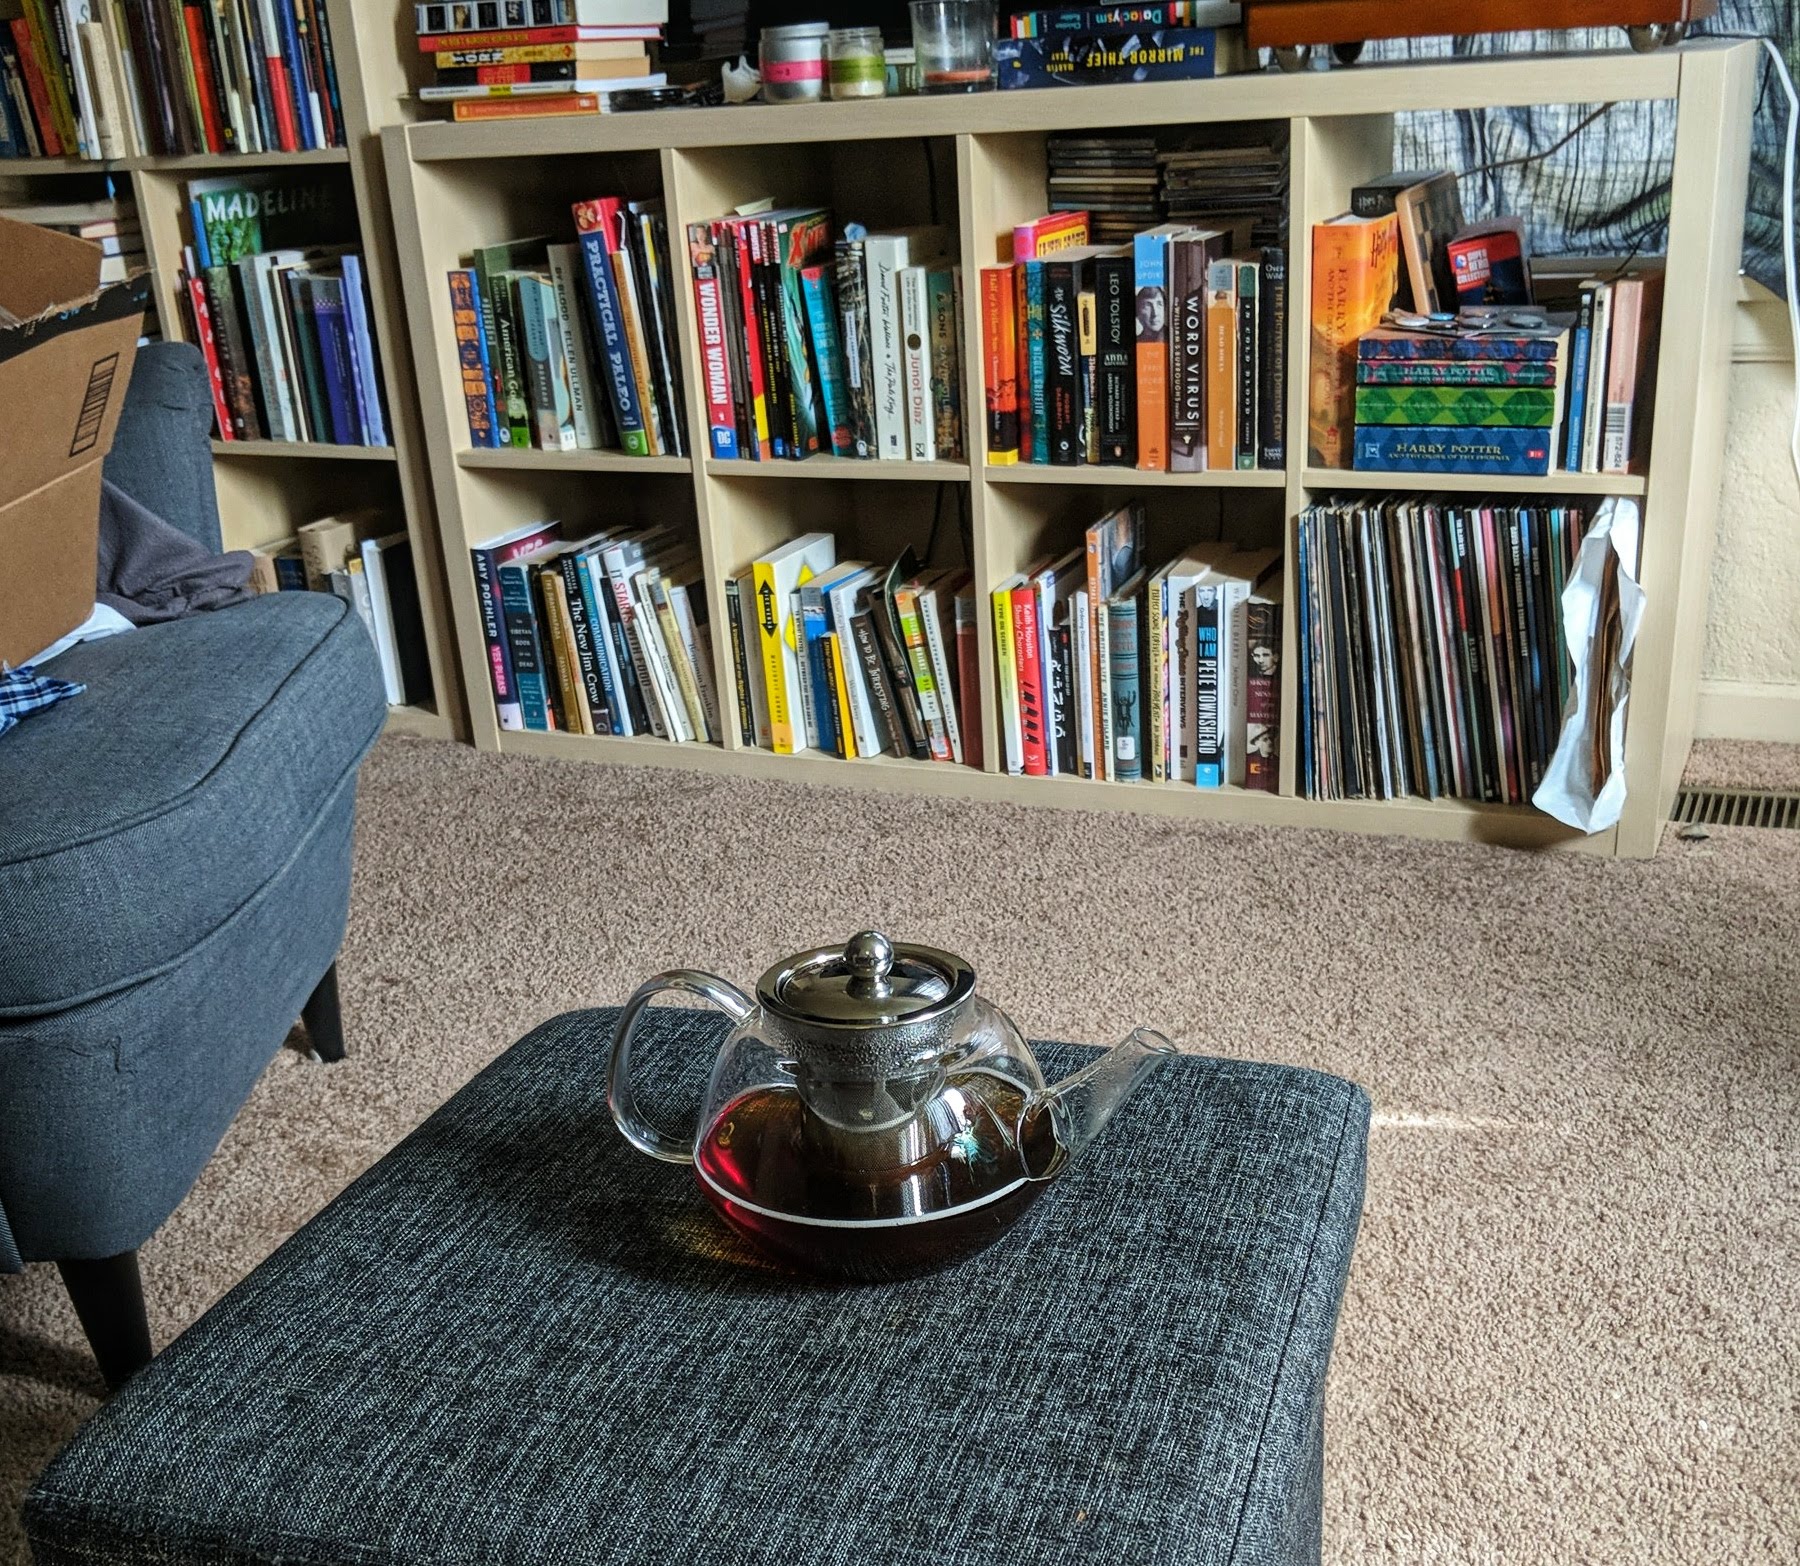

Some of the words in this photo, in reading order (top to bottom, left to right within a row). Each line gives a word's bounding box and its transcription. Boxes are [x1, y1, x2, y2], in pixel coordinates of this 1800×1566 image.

[1095, 6, 1162, 26] Dataclysm
[1085, 51, 1123, 67] THIEF
[1129, 47, 1183, 63] MIRROR
[1189, 46, 1204, 55] THE
[1108, 273, 1118, 294] LEO
[1274, 286, 1282, 307] THE
[555, 283, 570, 321] BLOOD
[696, 281, 723, 345] WONDER
[1336, 268, 1347, 334] HARRY
[585, 239, 619, 347] PRACTICAL
[608, 350, 632, 412] PALEO
[937, 307, 946, 337] SONS
[1109, 298, 1120, 344] TOLSTOY
[1185, 296, 1198, 356] WORD
[1273, 312, 1283, 350] PICTURE
[498, 317, 517, 378] American
[562, 330, 577, 365] ELLEN
[1049, 303, 1073, 376] Silkworm
[704, 346, 729, 405] WOMAN
[910, 353, 921, 391] Junot
[1032, 346, 1042, 375] NICOLA
[1404, 367, 1445, 375] HARRY
[1450, 367, 1495, 376] POTTER
[567, 367, 584, 412] ULLMAN
[1033, 378, 1044, 414] GRIFFITH
[1186, 363, 1199, 420] VIRUS
[1273, 373, 1282, 411] DORIAN
[1396, 443, 1445, 452] HARRY
[1451, 444, 1501, 454] POTTER
[1509, 526, 1517, 544] DAVID
[476, 553, 488, 580] AMY
[1511, 546, 1519, 566] BAZAN
[609, 568, 622, 580] IT
[480, 583, 497, 638] POEHLER
[569, 597, 585, 621] The
[613, 581, 634, 625] STARTS
[762, 588, 770, 606] VICE
[1150, 588, 1159, 609] PERFECT
[1012, 604, 1024, 630] Shady
[1021, 603, 1033, 625] Keith
[575, 622, 590, 650] New
[625, 625, 642, 655] WITH
[999, 631, 1007, 656] SCREEN
[1023, 625, 1036, 659] Houston
[1098, 630, 1107, 664] WRITING
[1151, 632, 1160, 658] FOREVER
[1199, 627, 1217, 641] WHO
[1205, 643, 1217, 657] AM
[490, 645, 502, 663] YES
[579, 649, 595, 672] Jim
[589, 617, 612, 692] COMMUNICATION
[1014, 630, 1026, 672] Characters
[493, 664, 507, 696] PLEASE
[634, 655, 652, 687] FOOD
[687, 642, 705, 684] Benjamin
[698, 683, 714, 719] Franklin
[862, 645, 873, 656] TO
[868, 666, 890, 712] INTERESTING
[1198, 659, 1215, 685] PETE
[585, 672, 602, 704] Crow
[1178, 676, 1186, 729] INTERVIEWS
[1102, 718, 1110, 750] DILLARD
[1197, 689, 1217, 754] TOWNSHEND
